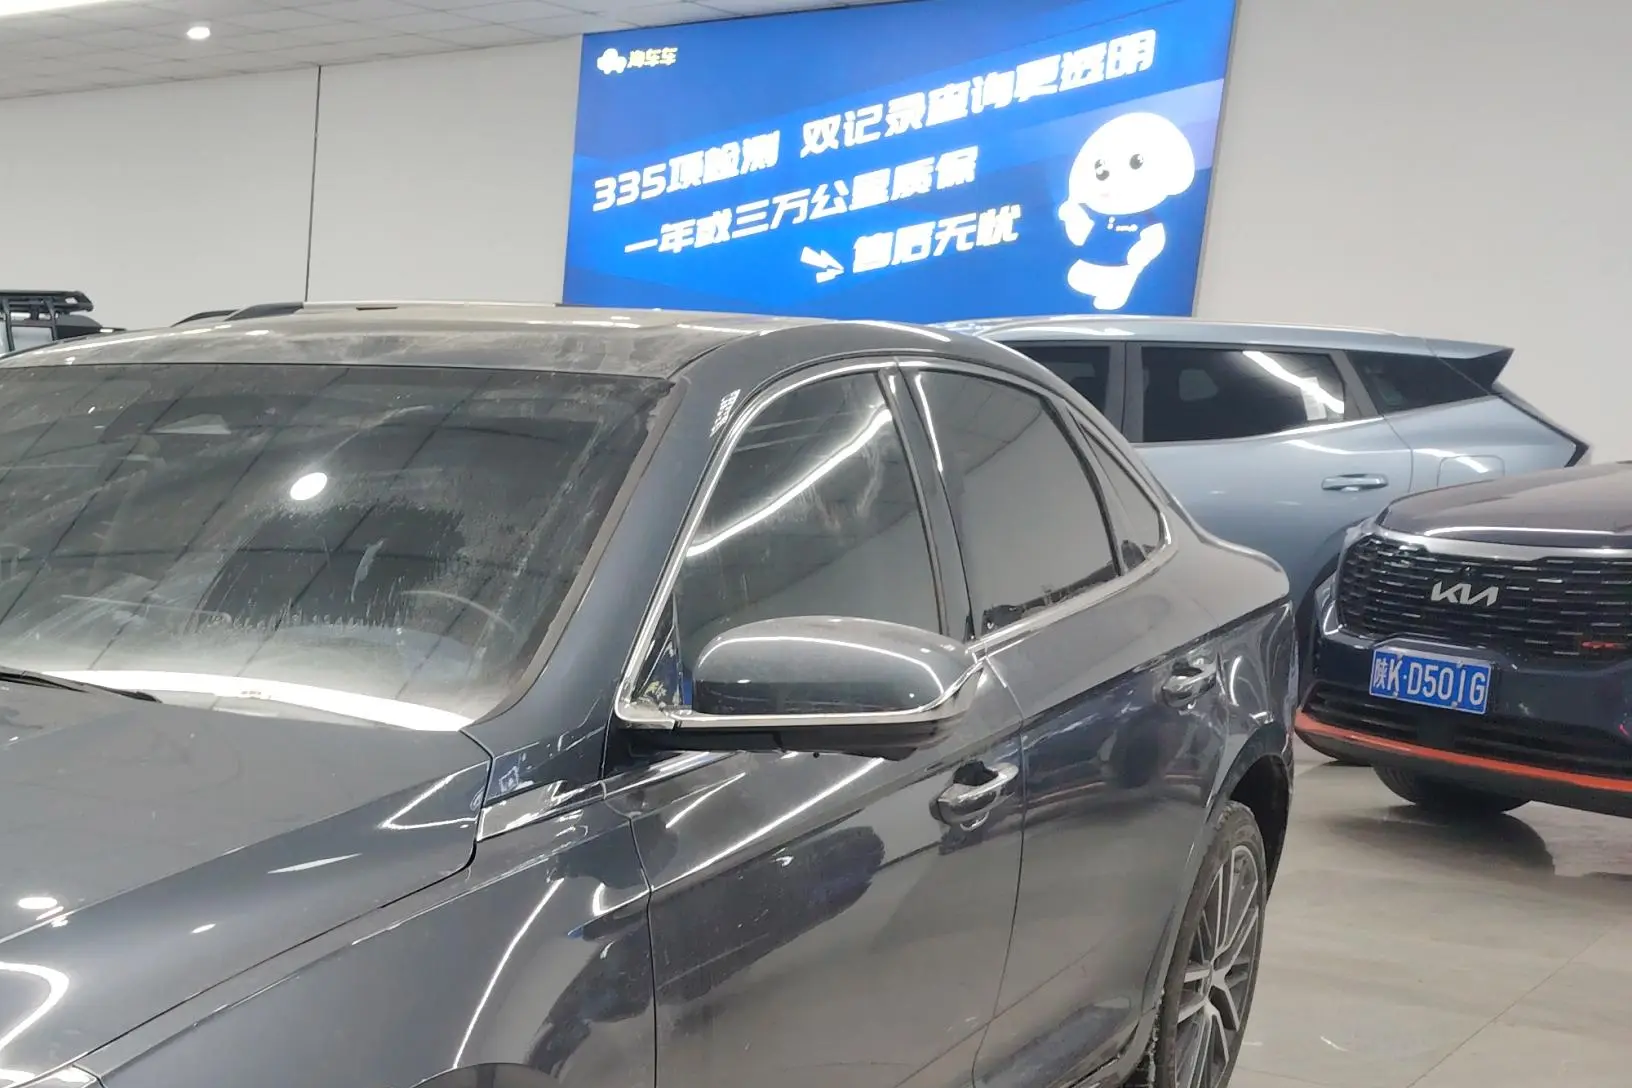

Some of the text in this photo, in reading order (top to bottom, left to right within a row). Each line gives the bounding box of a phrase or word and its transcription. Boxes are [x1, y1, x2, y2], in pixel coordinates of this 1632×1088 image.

[593, 29, 1156, 211] 335项检测 双记录查询更透明
[624, 146, 978, 254] 一年或三万公里质保
[852, 204, 1021, 273] 售后无忧
[1430, 581, 1499, 606] KIA
